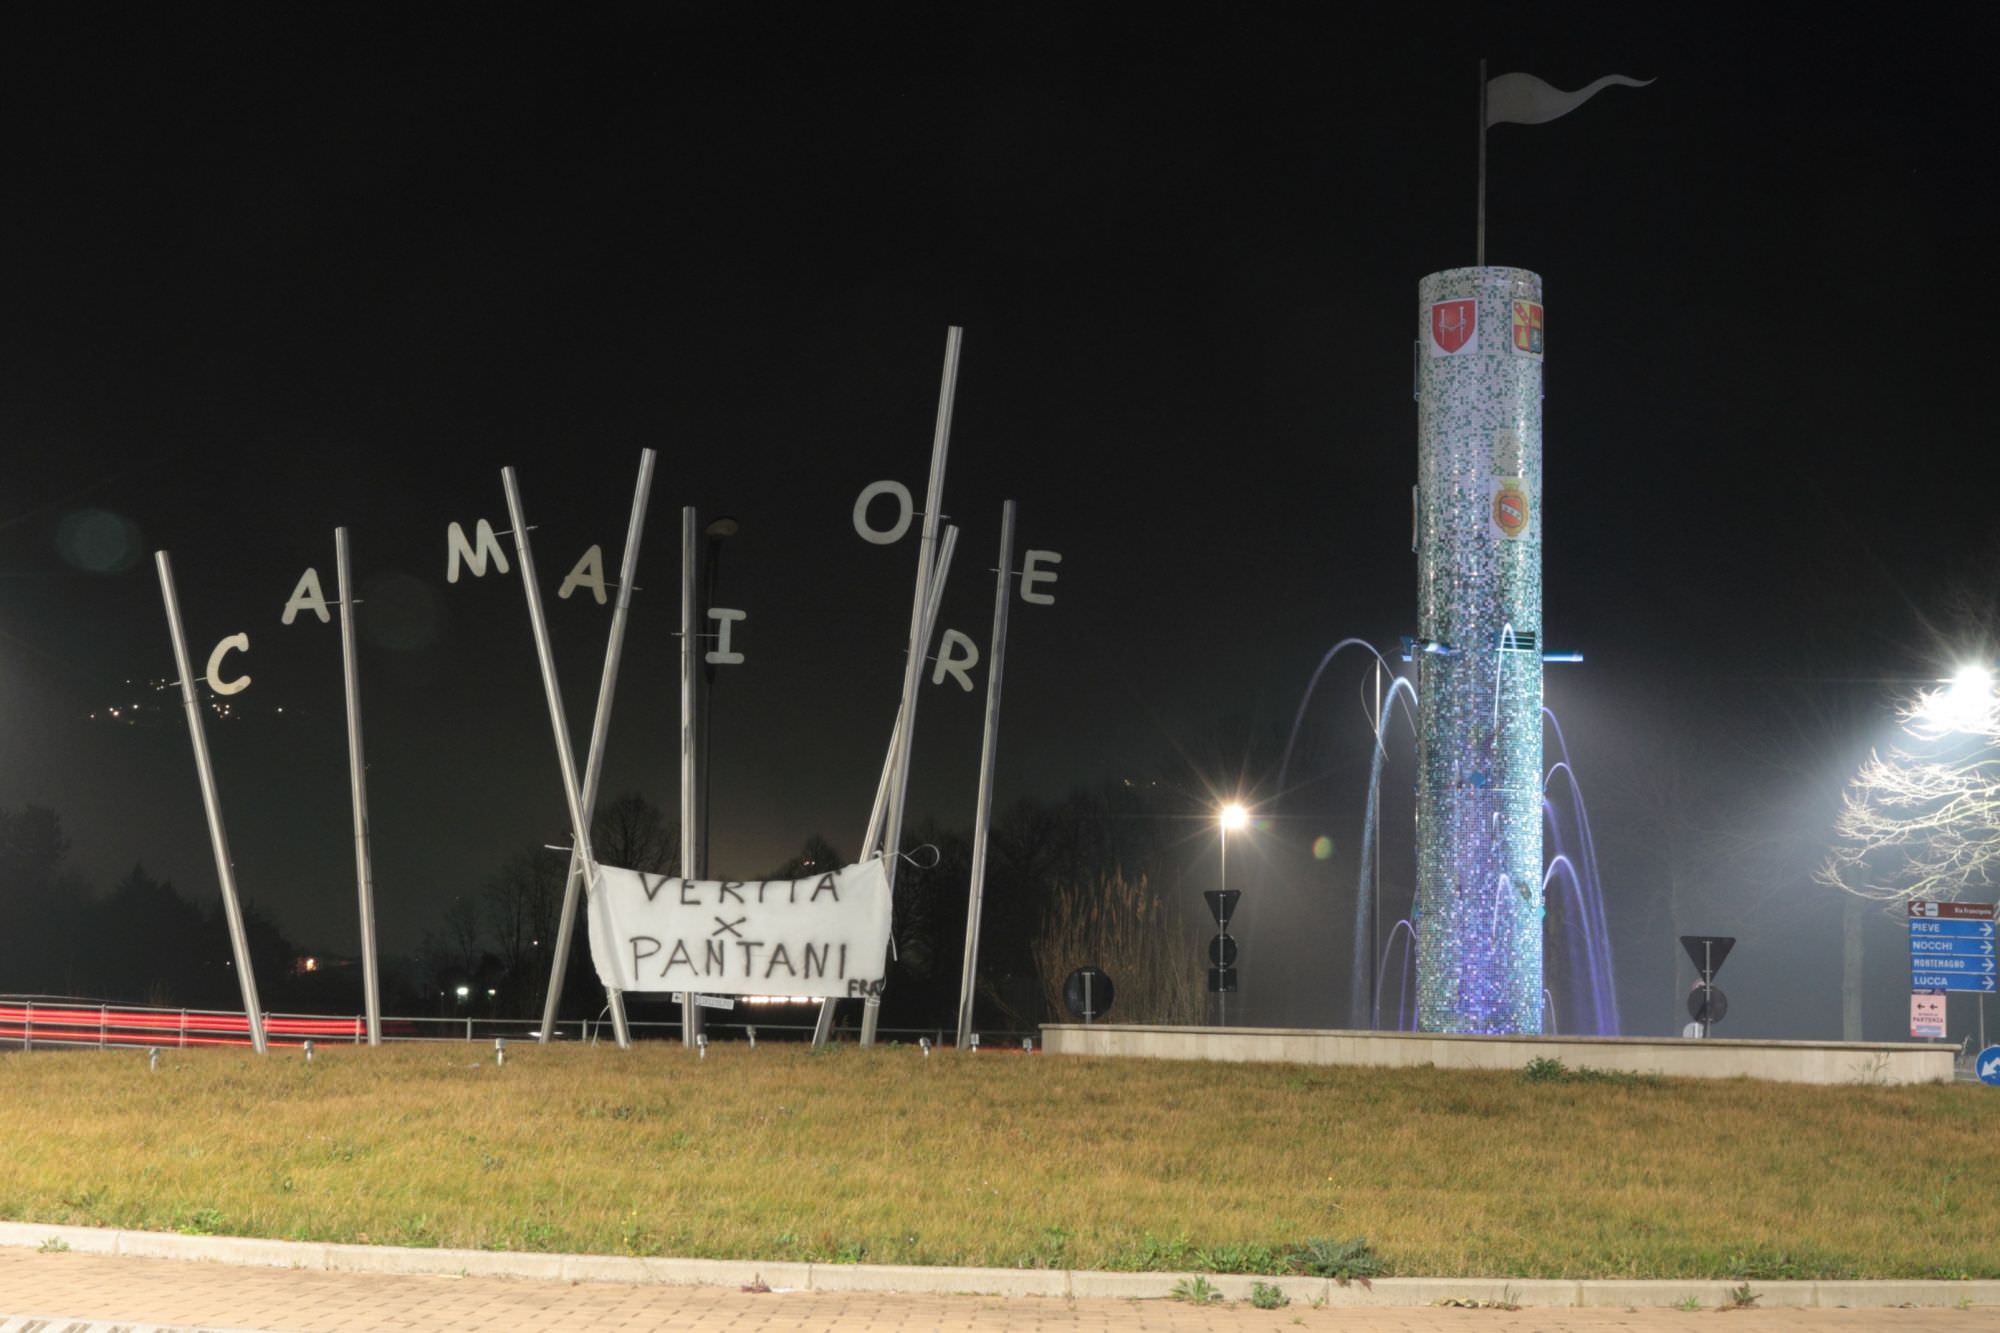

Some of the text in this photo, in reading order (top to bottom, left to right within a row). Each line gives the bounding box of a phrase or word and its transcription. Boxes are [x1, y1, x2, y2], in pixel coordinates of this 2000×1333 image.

[1912, 924, 1940, 932] PIEVE
[1912, 942, 1952, 950] NOCCHI
[629, 936, 847, 981] PANTANI
[1914, 977, 1948, 985] LUCCA
